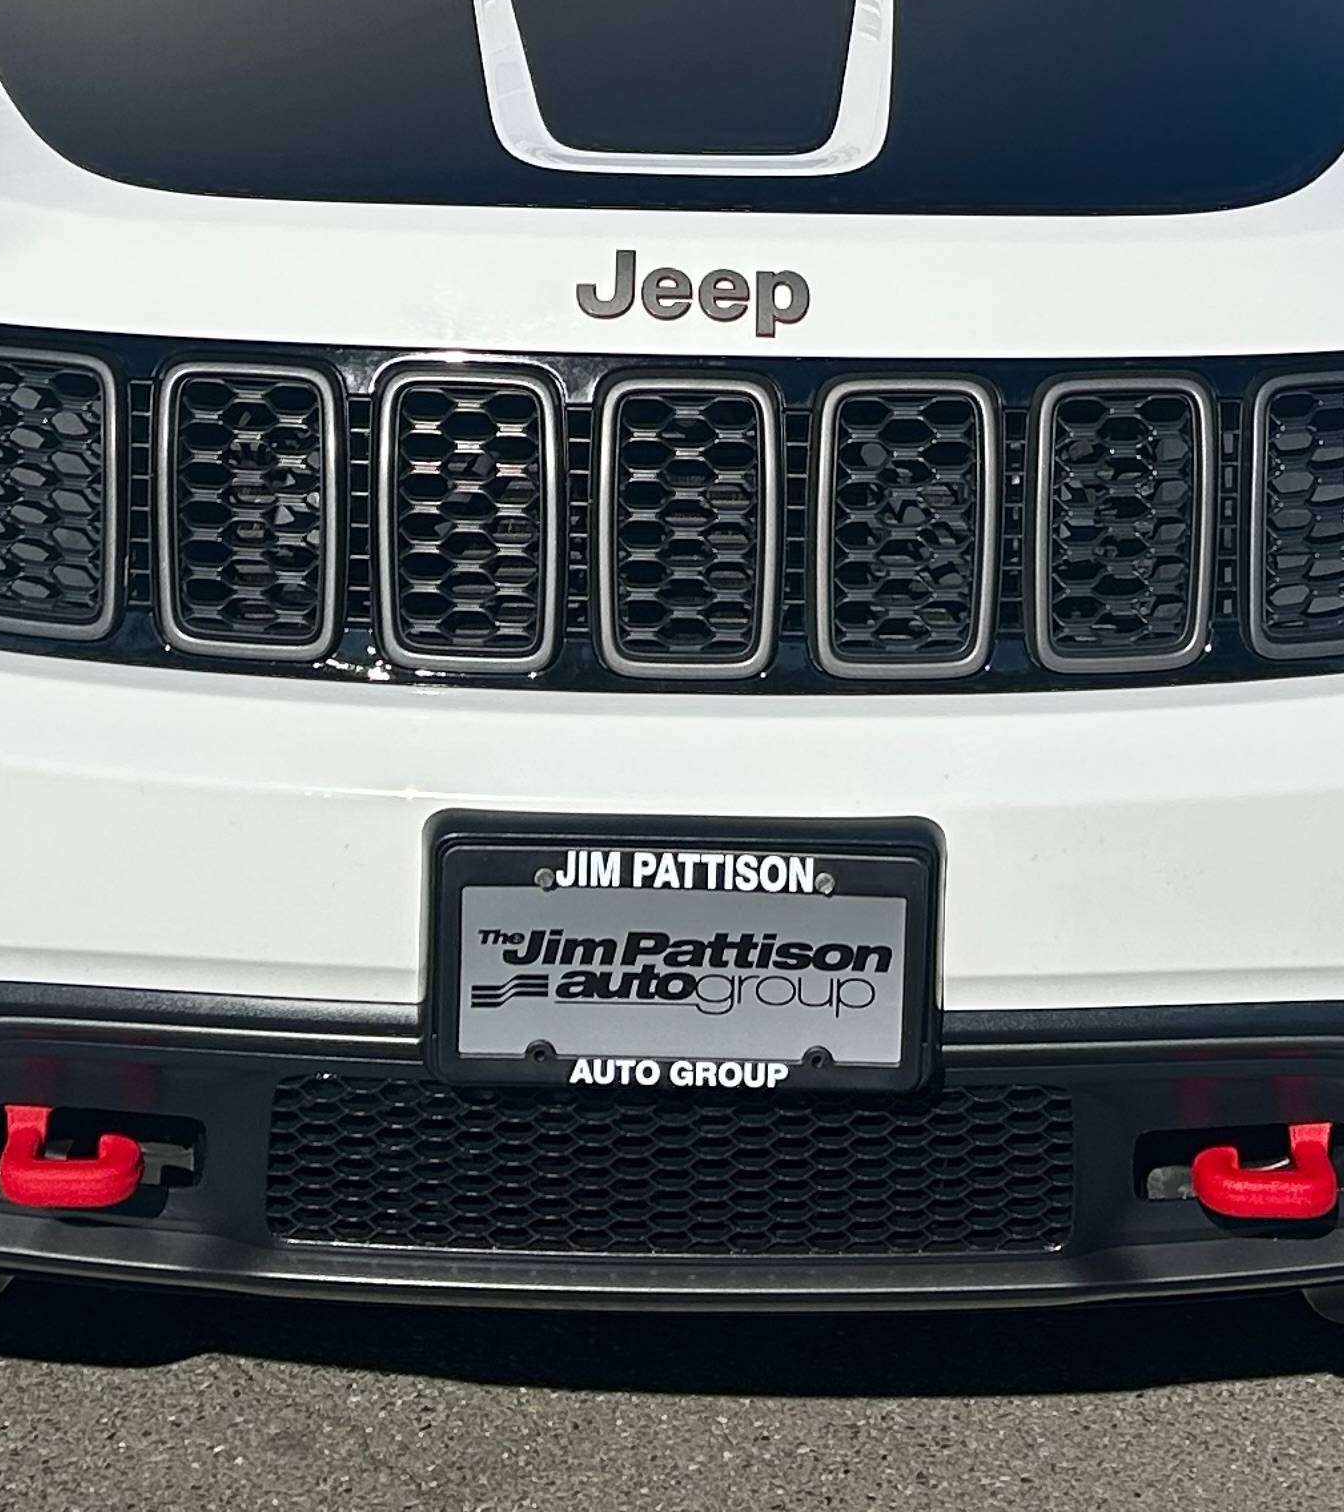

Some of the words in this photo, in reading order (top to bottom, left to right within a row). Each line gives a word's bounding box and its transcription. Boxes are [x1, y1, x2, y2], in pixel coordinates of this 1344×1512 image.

[576, 249, 810, 338] Jeep
[557, 851, 621, 887] JIM
[634, 853, 815, 893] PATTISON
[477, 929, 524, 946] The
[503, 929, 613, 966] Jim
[621, 931, 893, 973] Pattison
[570, 1059, 660, 1086] AUTO
[670, 1060, 789, 1088] GROUP
